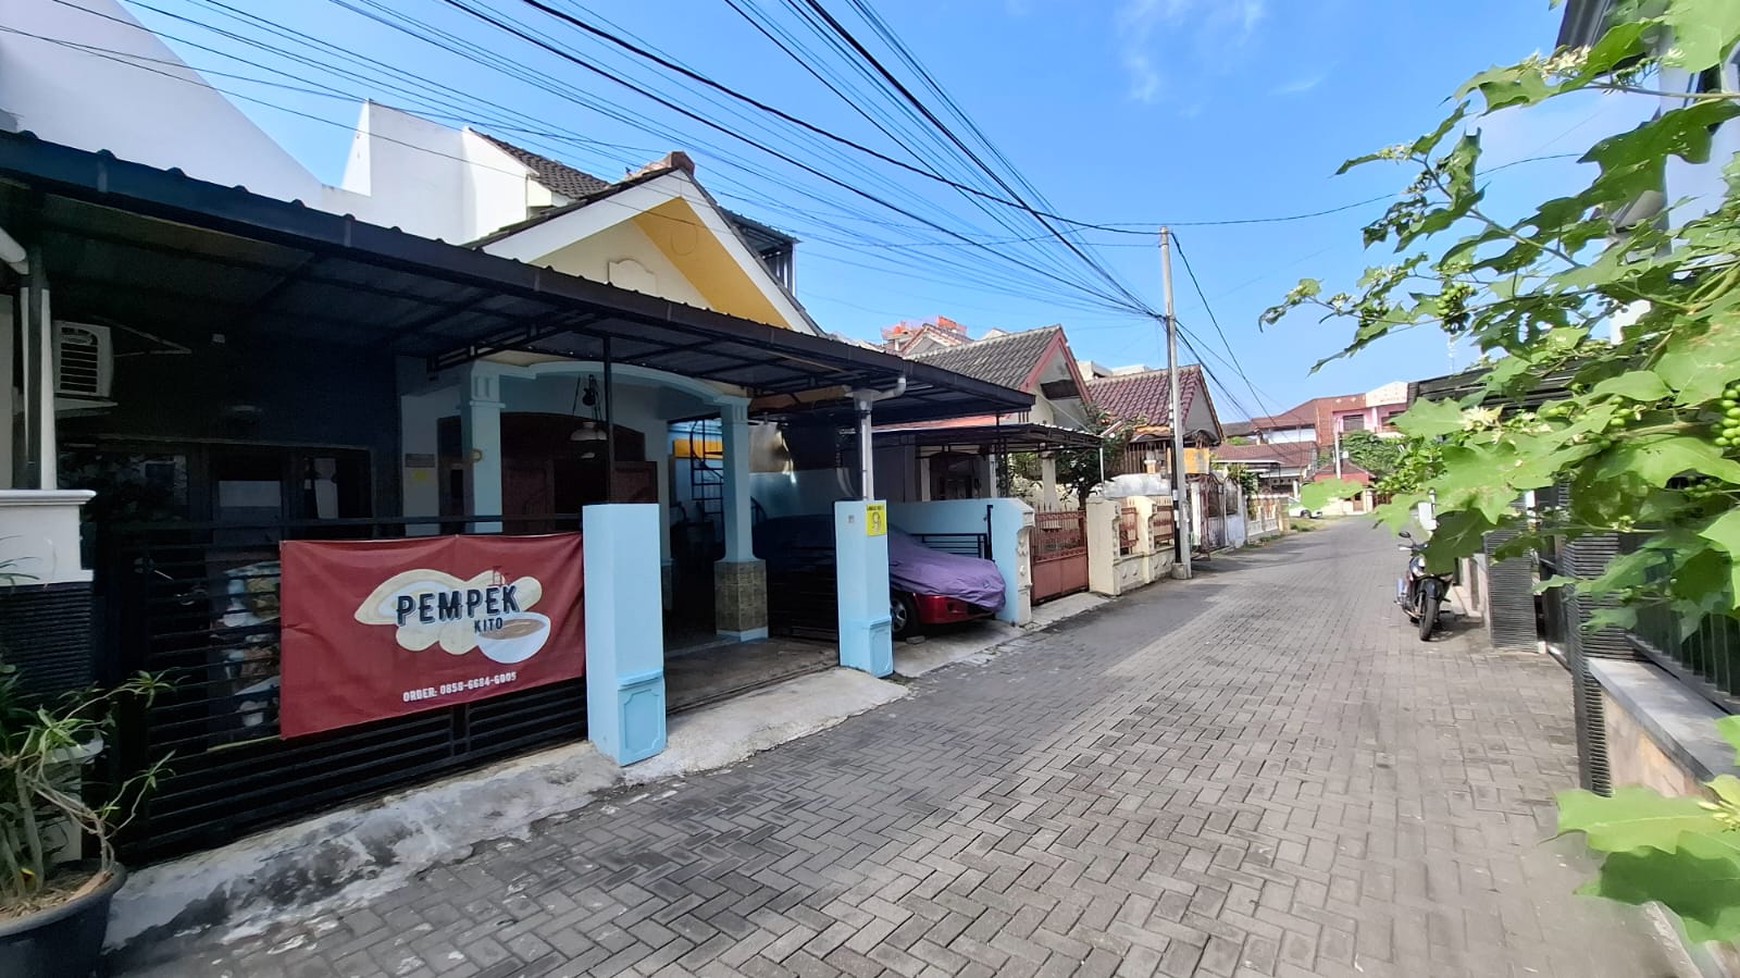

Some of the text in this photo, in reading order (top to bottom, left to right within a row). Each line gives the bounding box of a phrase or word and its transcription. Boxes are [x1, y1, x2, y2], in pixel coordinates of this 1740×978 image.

[397, 585, 520, 626] PEMPEK
[474, 617, 503, 633] KITO
[403, 687, 437, 702] ORDER:
